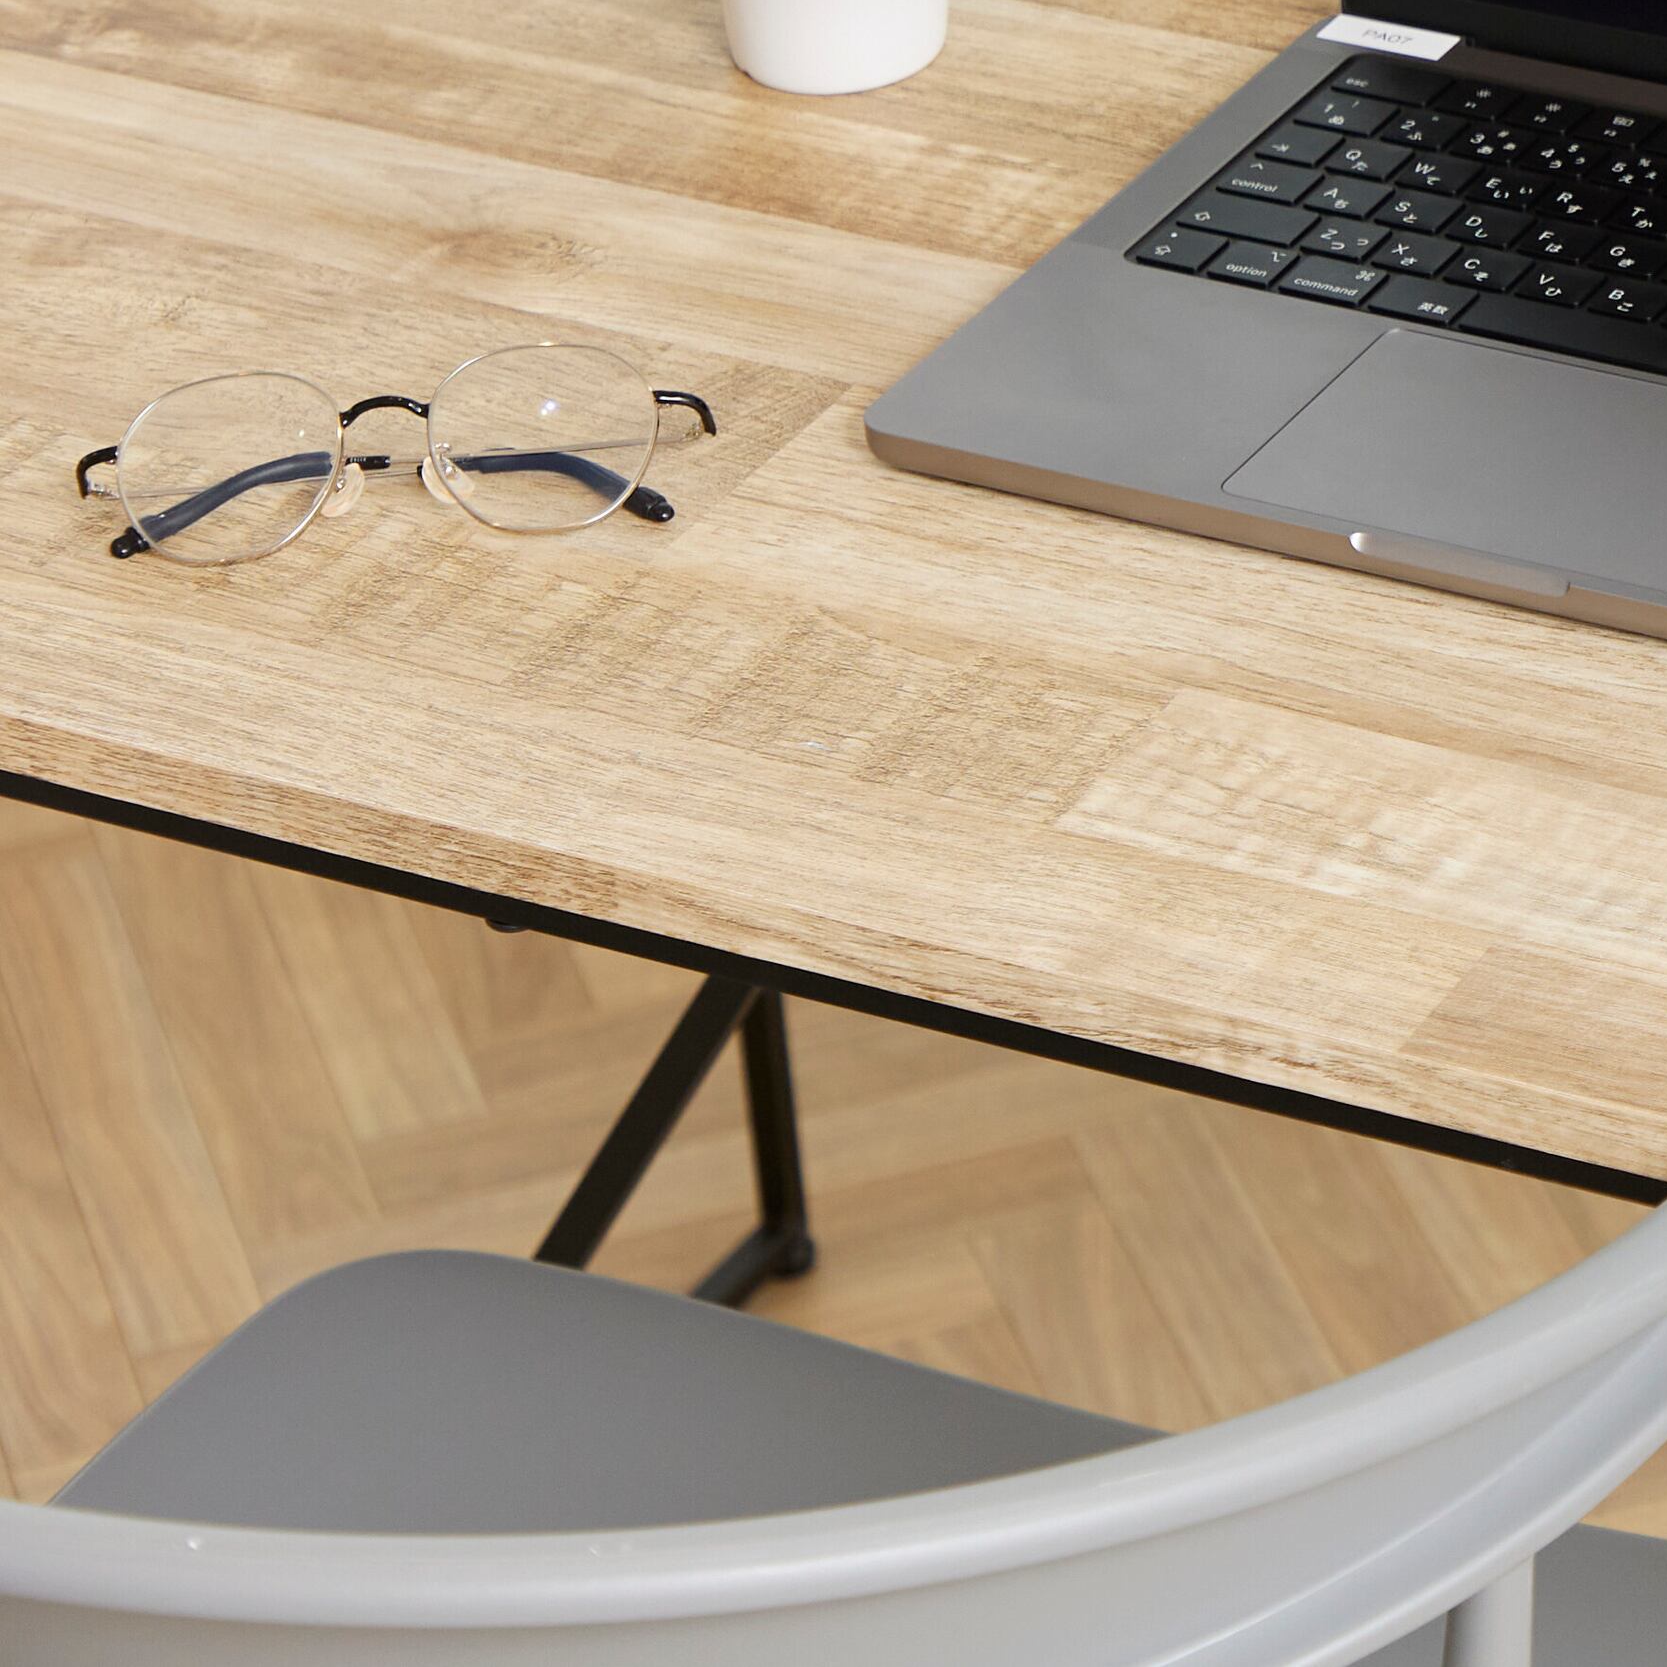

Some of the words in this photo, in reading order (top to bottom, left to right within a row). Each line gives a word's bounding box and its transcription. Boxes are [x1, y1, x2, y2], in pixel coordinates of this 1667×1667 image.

[1231, 176, 1278, 194] control
[1225, 260, 1268, 278] option
[1293, 276, 1359, 298] command
